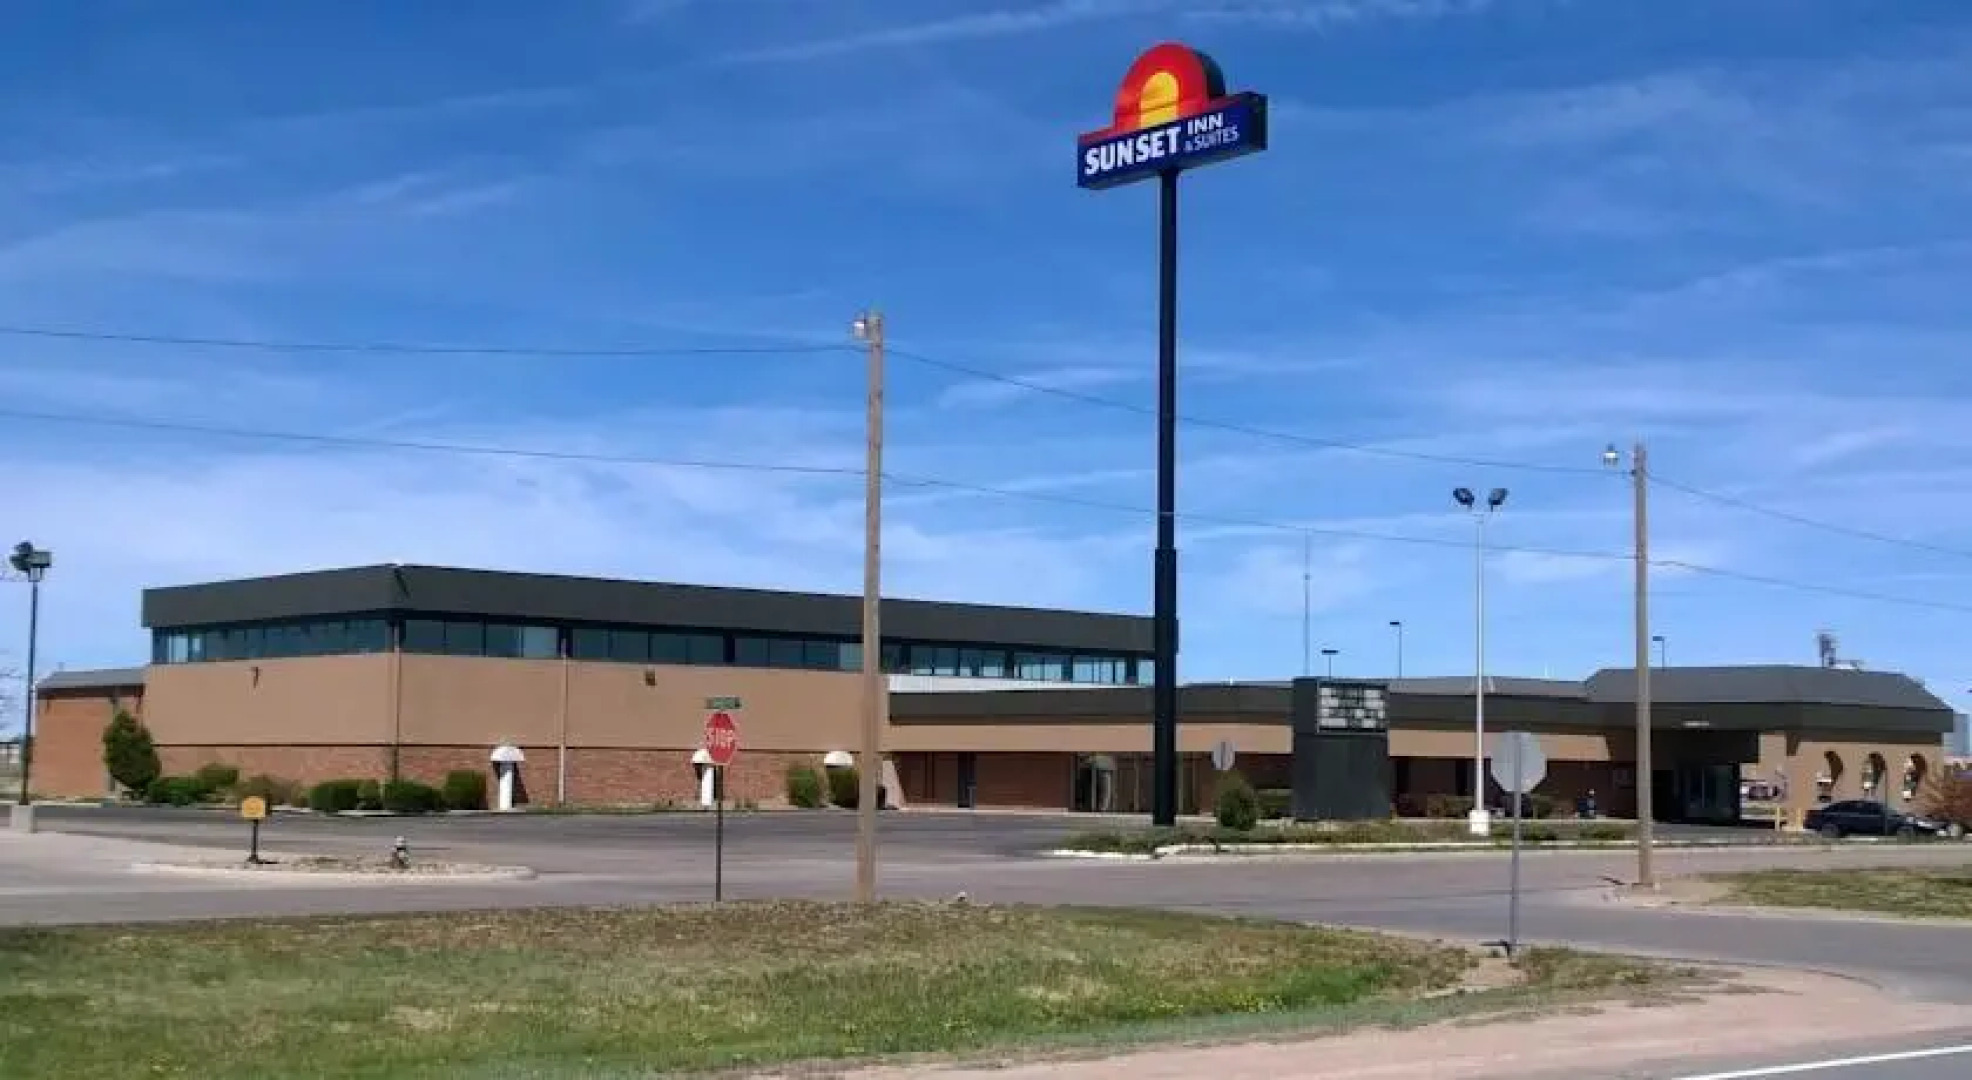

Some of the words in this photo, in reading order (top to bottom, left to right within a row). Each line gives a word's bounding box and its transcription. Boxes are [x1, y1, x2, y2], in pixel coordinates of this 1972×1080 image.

[1084, 126, 1181, 175] SUNSET
[1187, 112, 1223, 136] INN
[1194, 125, 1239, 151] SUITES
[706, 727, 735, 749] STOP
